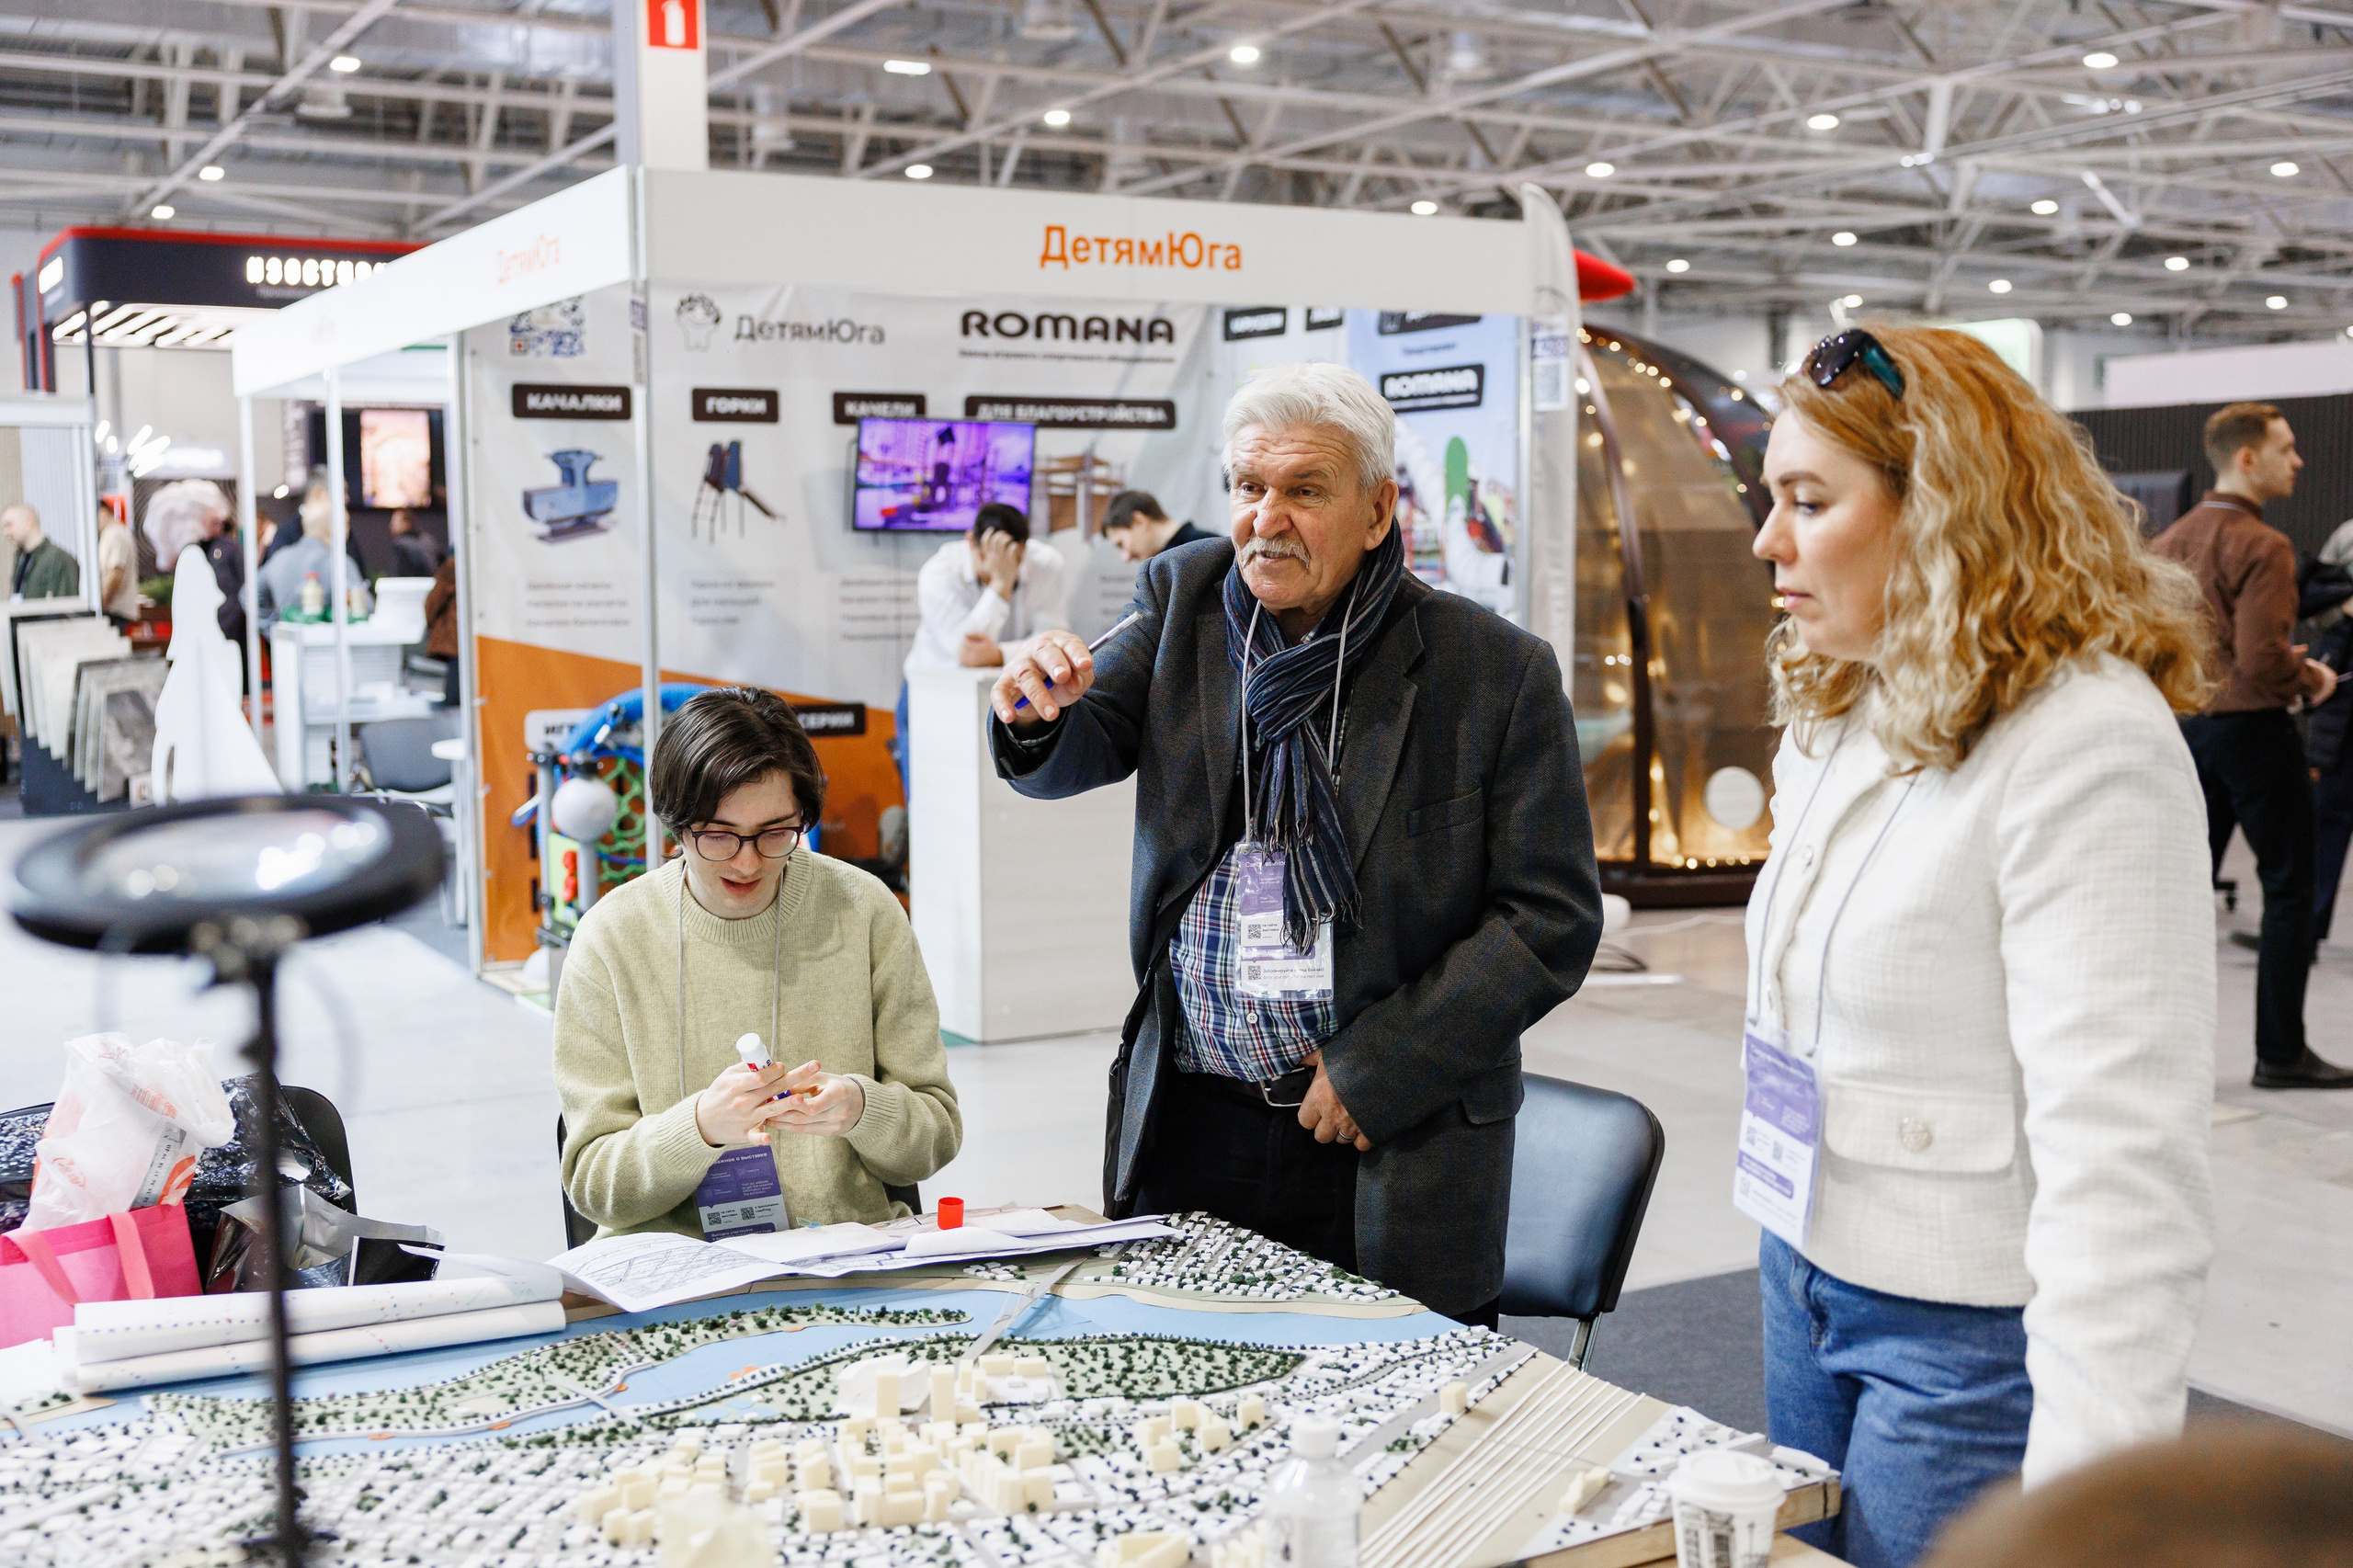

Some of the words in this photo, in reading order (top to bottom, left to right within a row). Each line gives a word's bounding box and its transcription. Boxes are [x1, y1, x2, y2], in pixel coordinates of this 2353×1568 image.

[1040, 224, 1242, 270] ДетямЮга
[734, 315, 885, 346] ДетямЮга
[961, 311, 1174, 344] ROMANA
[527, 394, 623, 412] КАЧАЛКИ
[705, 397, 767, 415] ГОРКИ
[844, 401, 916, 417] КАЧЕЛИ
[976, 403, 1012, 419] ДЛЯ
[1015, 404, 1167, 425] БЛАГОУСТРОЙСТВА
[165, 1144, 171, 1153] 40
[741, 1152, 768, 1161] выставке
